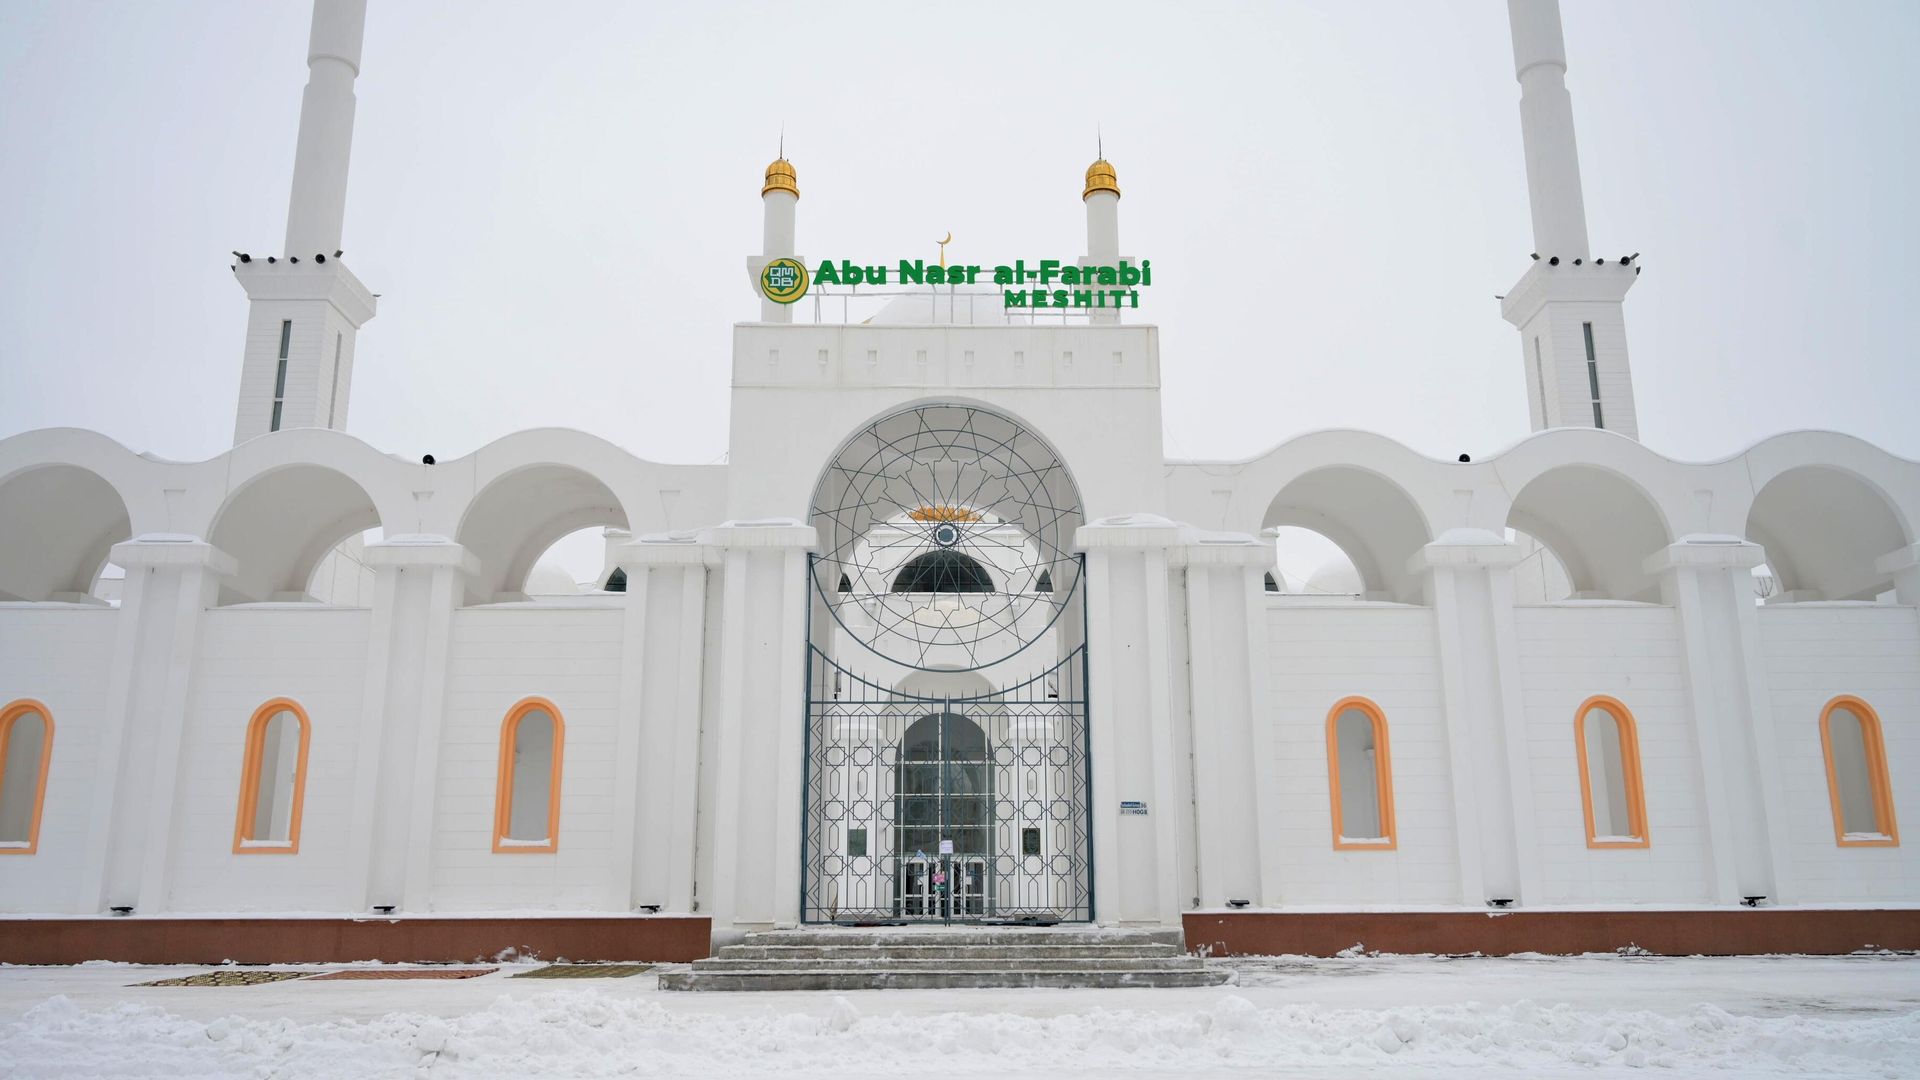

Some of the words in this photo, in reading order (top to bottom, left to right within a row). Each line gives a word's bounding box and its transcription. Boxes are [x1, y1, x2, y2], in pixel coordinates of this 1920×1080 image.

[813, 259, 887, 285] Abu
[899, 259, 981, 285] Nasr
[993, 259, 1151, 286] al-Farabi
[1004, 289, 1139, 308] MESHITI
